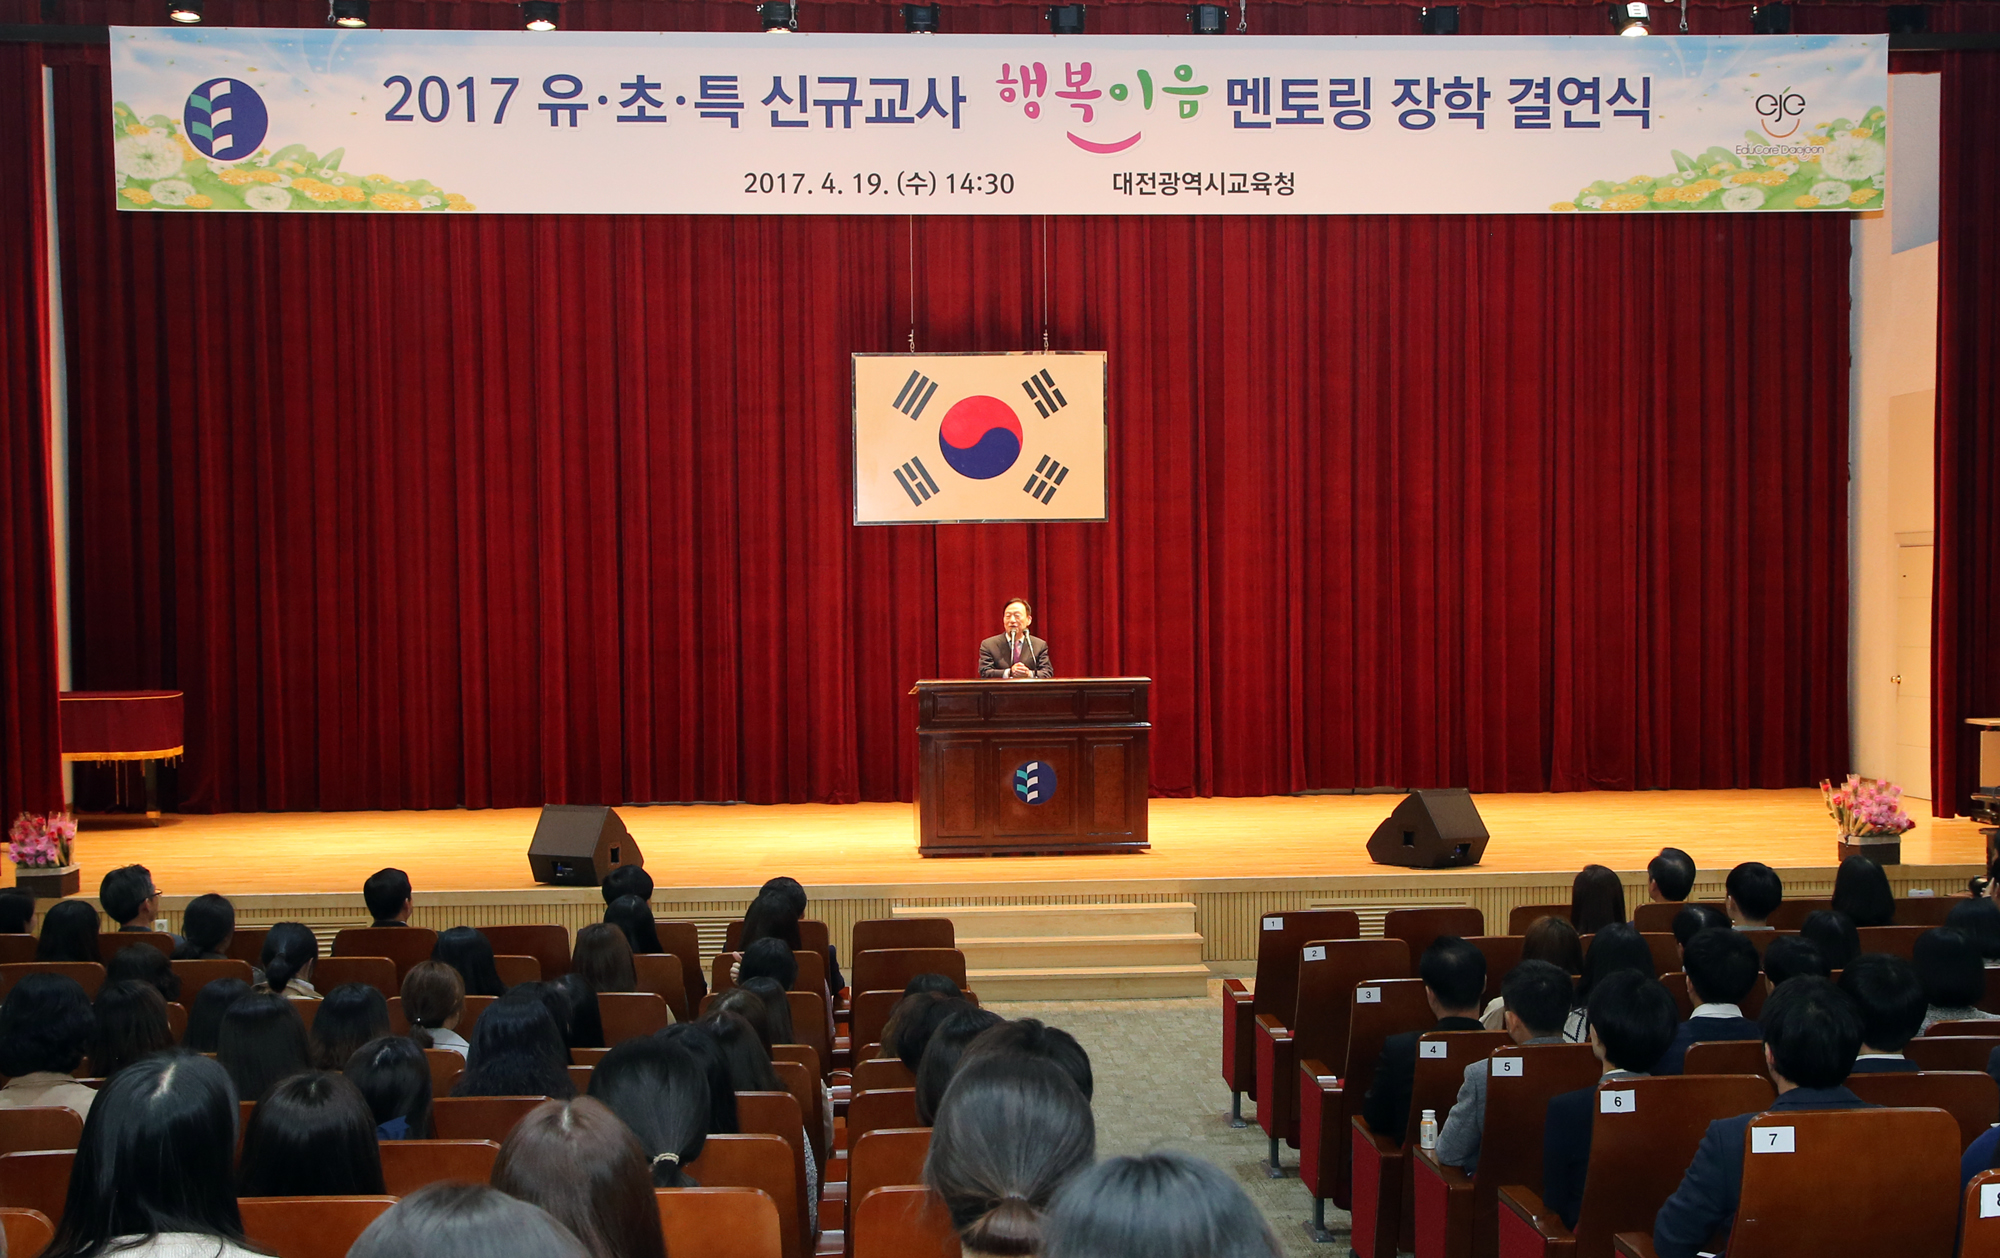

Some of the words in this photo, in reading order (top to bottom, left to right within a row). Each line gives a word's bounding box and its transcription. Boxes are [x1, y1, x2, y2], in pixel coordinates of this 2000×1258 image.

[384, 76, 521, 125] 2017
[538, 74, 746, 129] 유·초·특
[761, 75, 968, 130] 신규교사
[996, 62, 1209, 124] 행복이음
[1227, 77, 1373, 131] 멘토링
[1392, 76, 1493, 131] 장학
[1508, 77, 1652, 131] 결연식
[744, 173, 814, 196] 2017.
[822, 173, 845, 196] 4.
[854, 173, 890, 196] 19.
[898, 171, 938, 198] (수)
[946, 173, 1016, 196] 14:30
[1113, 172, 1297, 197] 대전광역시교육청
[1365, 990, 1371, 999] 3
[1430, 1045, 1436, 1054] 4
[1504, 1062, 1511, 1072] 5
[1614, 1096, 1621, 1107] 6
[1768, 1133, 1778, 1146] 7
